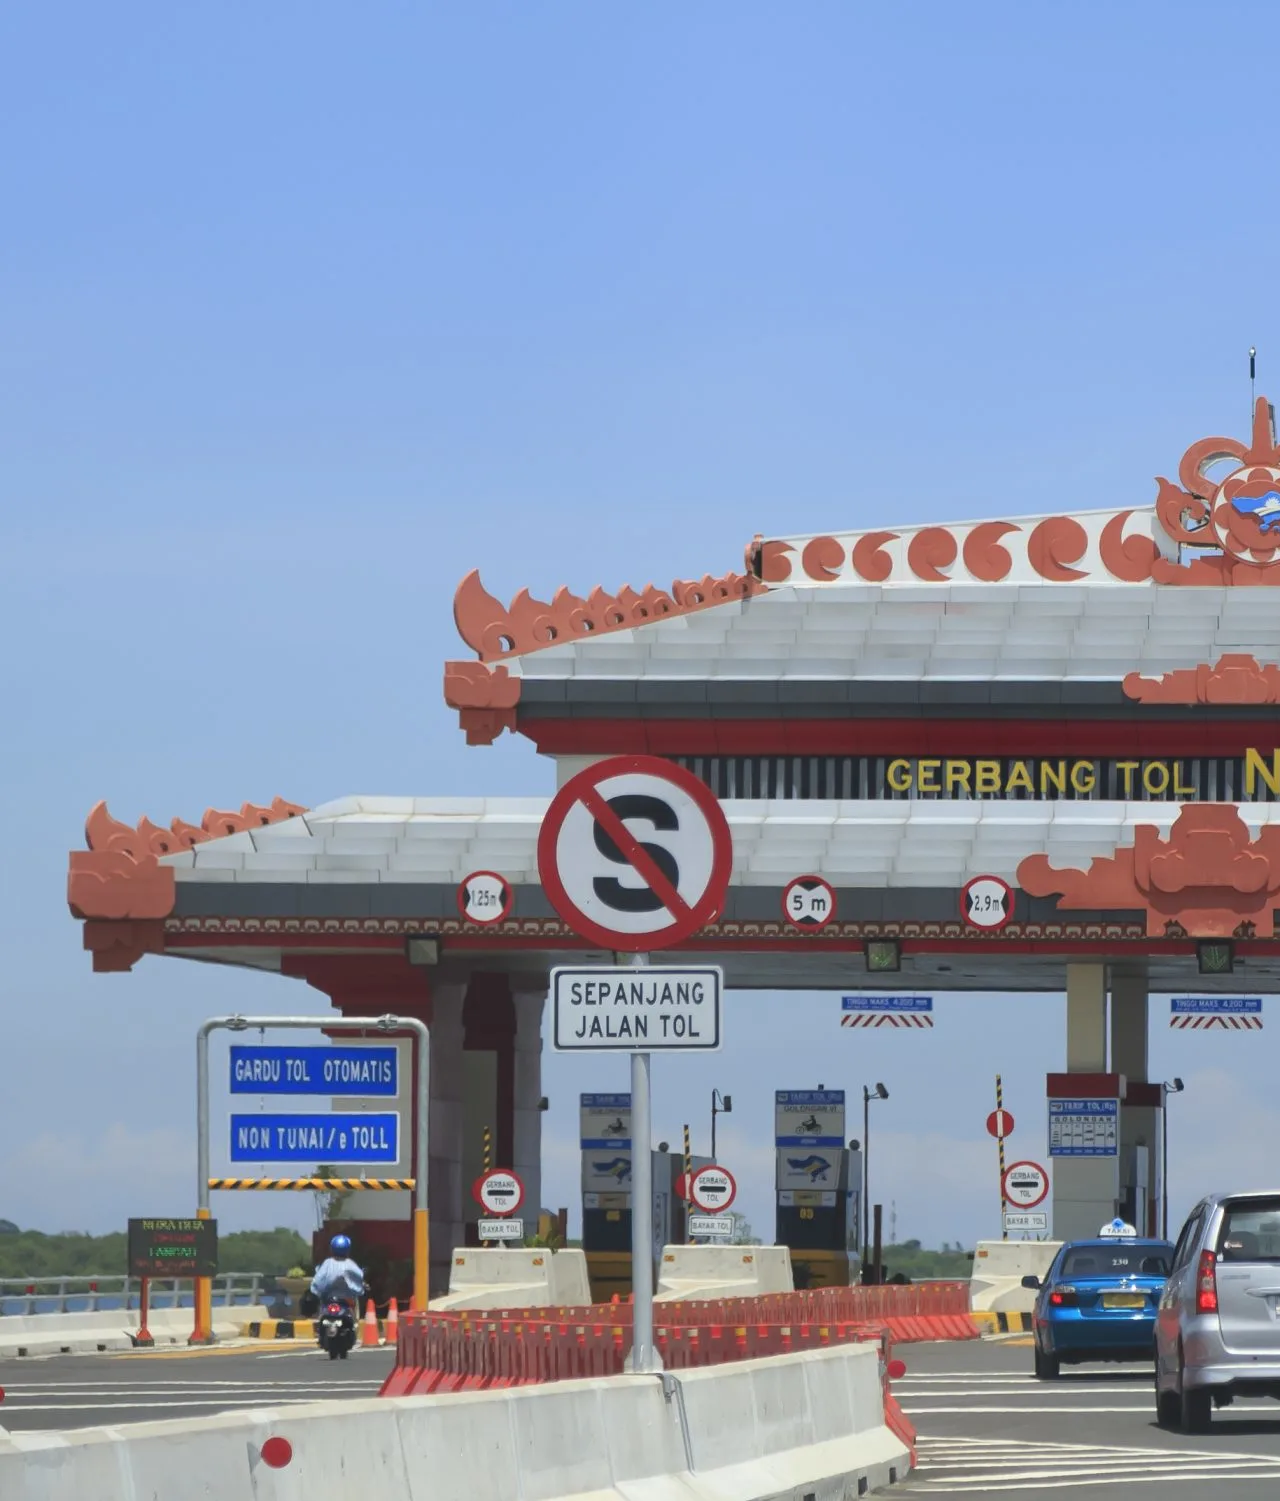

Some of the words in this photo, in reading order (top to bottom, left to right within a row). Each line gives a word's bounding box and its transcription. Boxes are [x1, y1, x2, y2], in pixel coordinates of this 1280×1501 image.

[886, 758, 1096, 794] GERBANG
[1116, 761, 1197, 795] TOL
[592, 794, 680, 913] S
[793, 894, 803, 911] 5
[811, 898, 826, 911] m
[570, 982, 704, 1006] SEPANJANG
[575, 1015, 649, 1038] JALAN
[659, 1014, 700, 1038] TOL
[235, 1059, 281, 1082] GARDU
[285, 1059, 311, 1082] TOL
[323, 1060, 392, 1083] OTOMATIS
[237, 1126, 271, 1149] NON
[352, 1126, 389, 1150] TOLL
[698, 1176, 728, 1185] GERBANG
[1010, 1172, 1040, 1180] GERBANG
[486, 1181, 515, 1189] GERBANG
[706, 1194, 719, 1202] TOL
[1019, 1190, 1032, 1198] TOL
[1006, 1217, 1029, 1225] BAYAR
[1033, 1217, 1045, 1225] TOL
[506, 1224, 520, 1233] TOL
[692, 1222, 716, 1230] BAYAR
[717, 1222, 730, 1230] TOL
